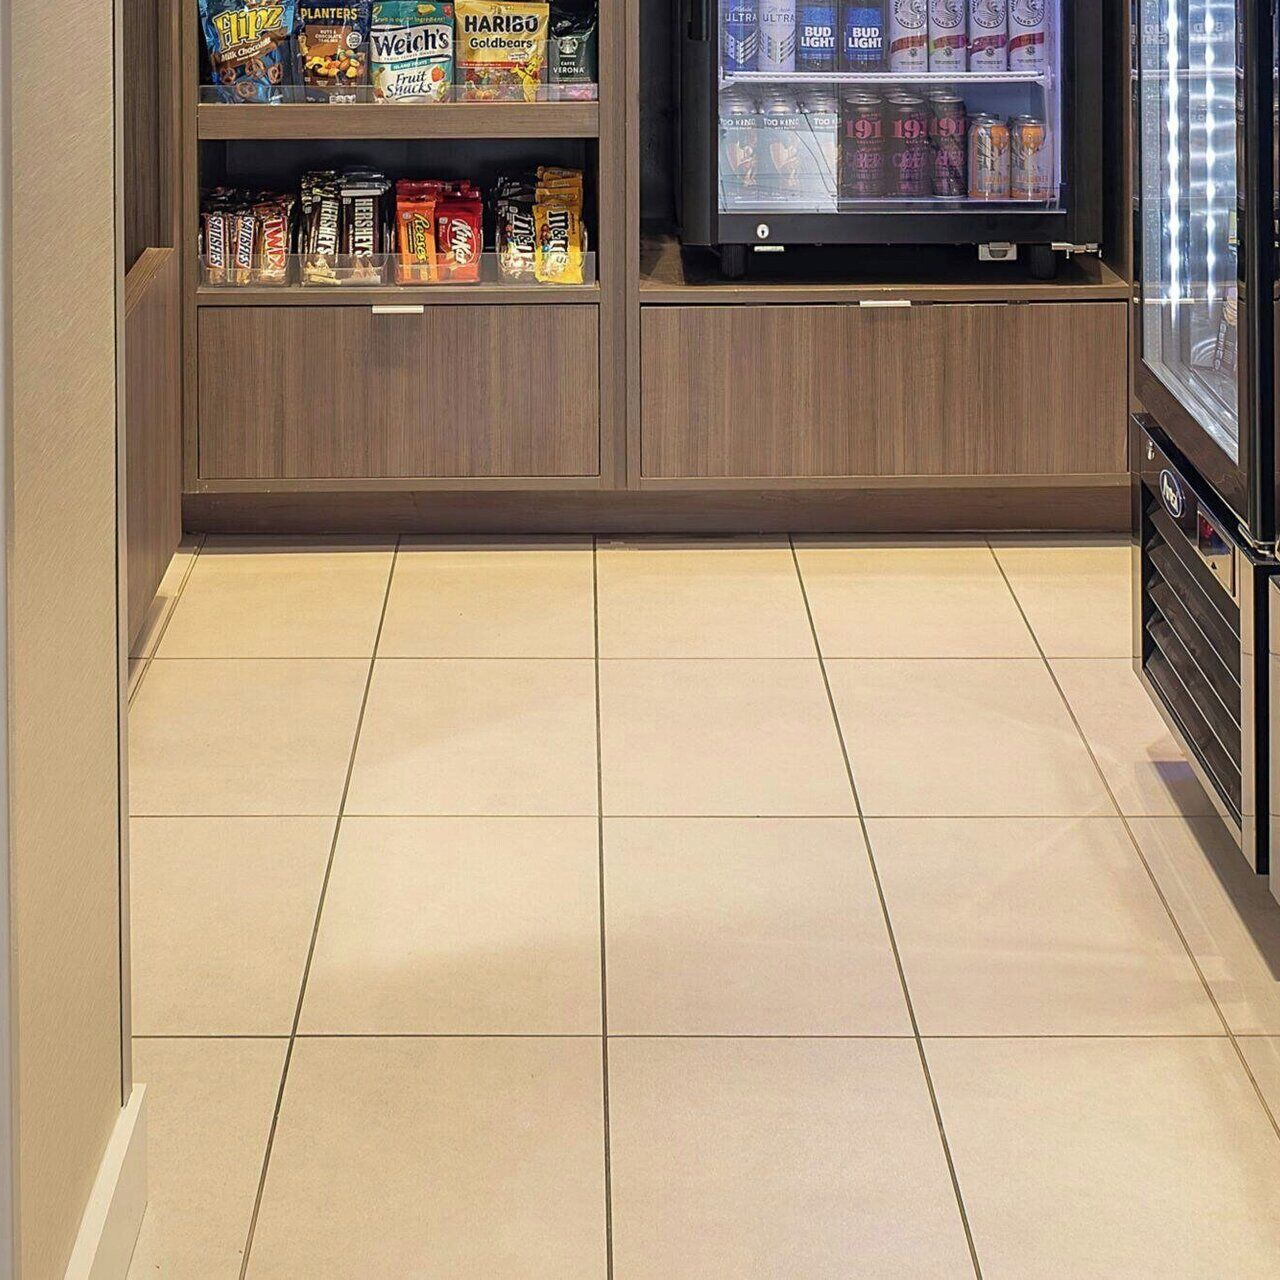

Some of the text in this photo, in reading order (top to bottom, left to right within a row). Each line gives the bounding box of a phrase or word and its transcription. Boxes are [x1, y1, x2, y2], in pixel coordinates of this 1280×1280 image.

[300, 7, 358, 21] PLANTERS
[725, 12, 758, 22] ULTRA
[763, 14, 795, 22] ULTRA
[215, 6, 284, 51] Flipz
[464, 15, 538, 33] HARIBO
[804, 26, 832, 37] BUD
[852, 27, 880, 38] BUD
[372, 28, 449, 57] Welch's
[470, 37, 533, 49] Goldbears
[801, 37, 835, 48] LIGHT
[848, 37, 882, 48] LIGHT
[396, 69, 428, 84] Fruit
[385, 82, 433, 98] Snacks
[845, 119, 882, 139] 191
[317, 200, 339, 255] HERSHEY'S
[354, 198, 373, 258] HERSHEY'S
[413, 213, 430, 262] Reese's
